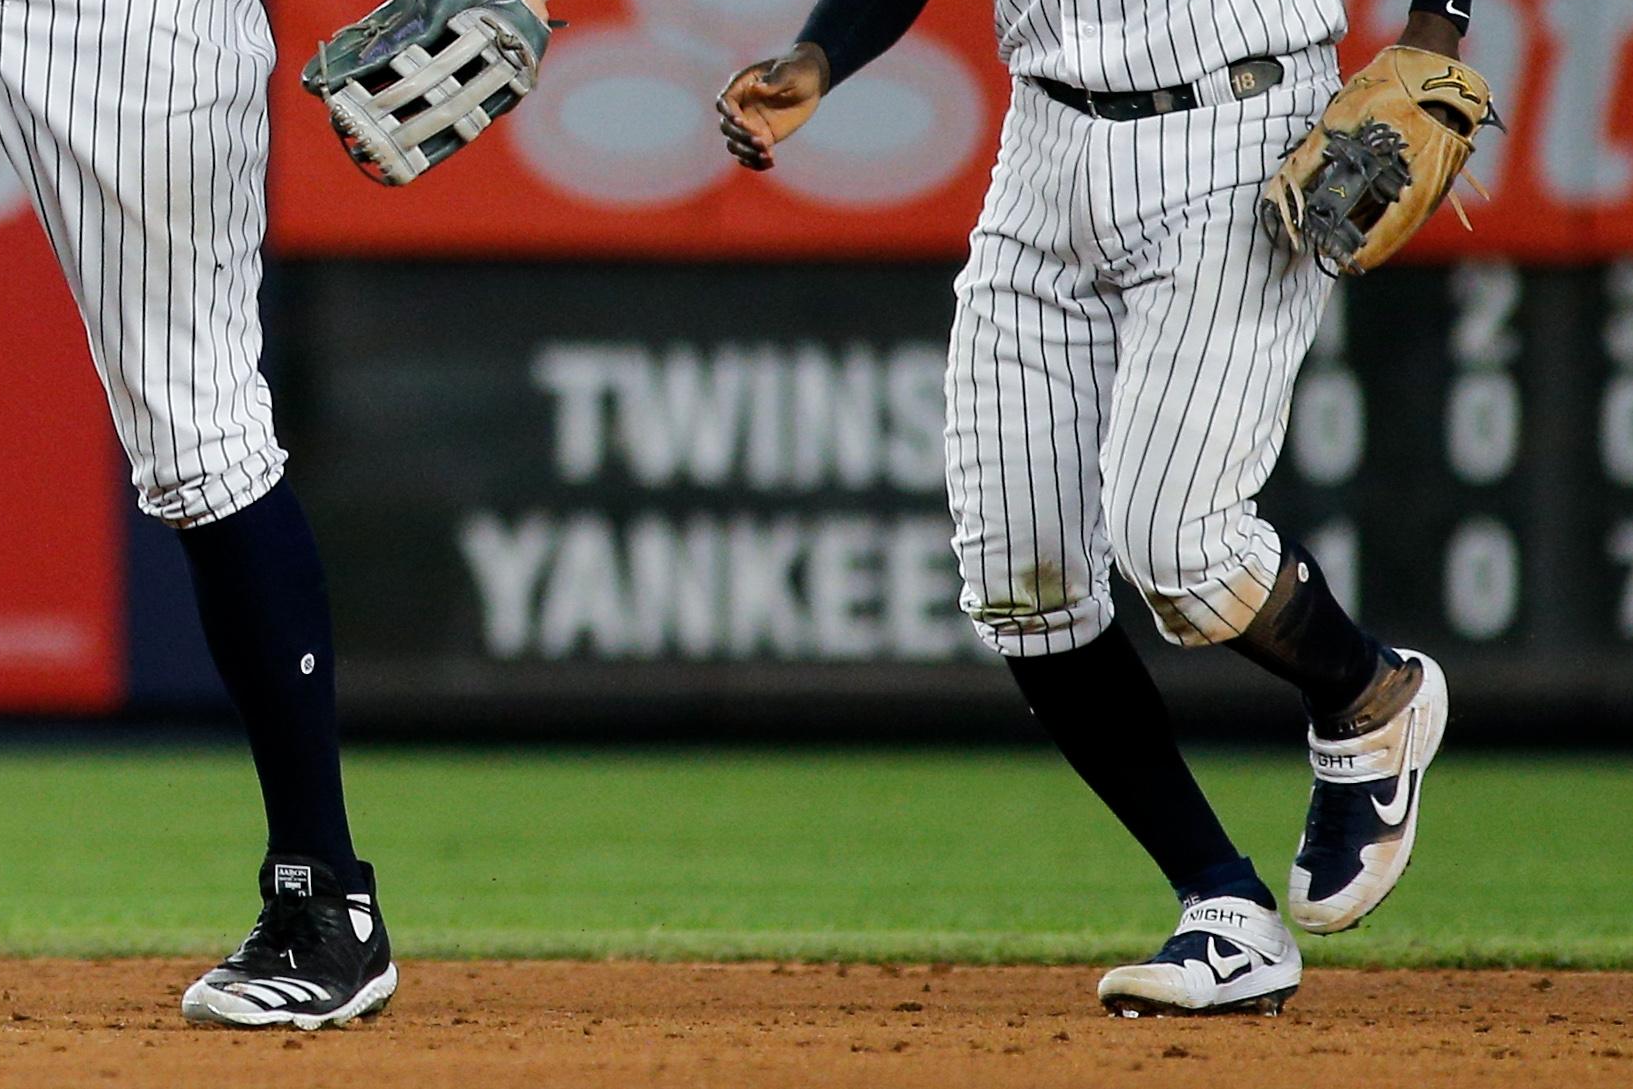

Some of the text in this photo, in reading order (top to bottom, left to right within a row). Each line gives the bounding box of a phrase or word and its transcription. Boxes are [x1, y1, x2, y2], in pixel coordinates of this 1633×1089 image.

[1232, 72, 1256, 93] 18
[1446, 257, 1524, 364] 2
[530, 338, 948, 492] TWINS
[1291, 365, 1366, 489] 0
[1445, 365, 1523, 487] 0
[461, 514, 988, 662] YANKEE
[1444, 515, 1520, 640] 0
